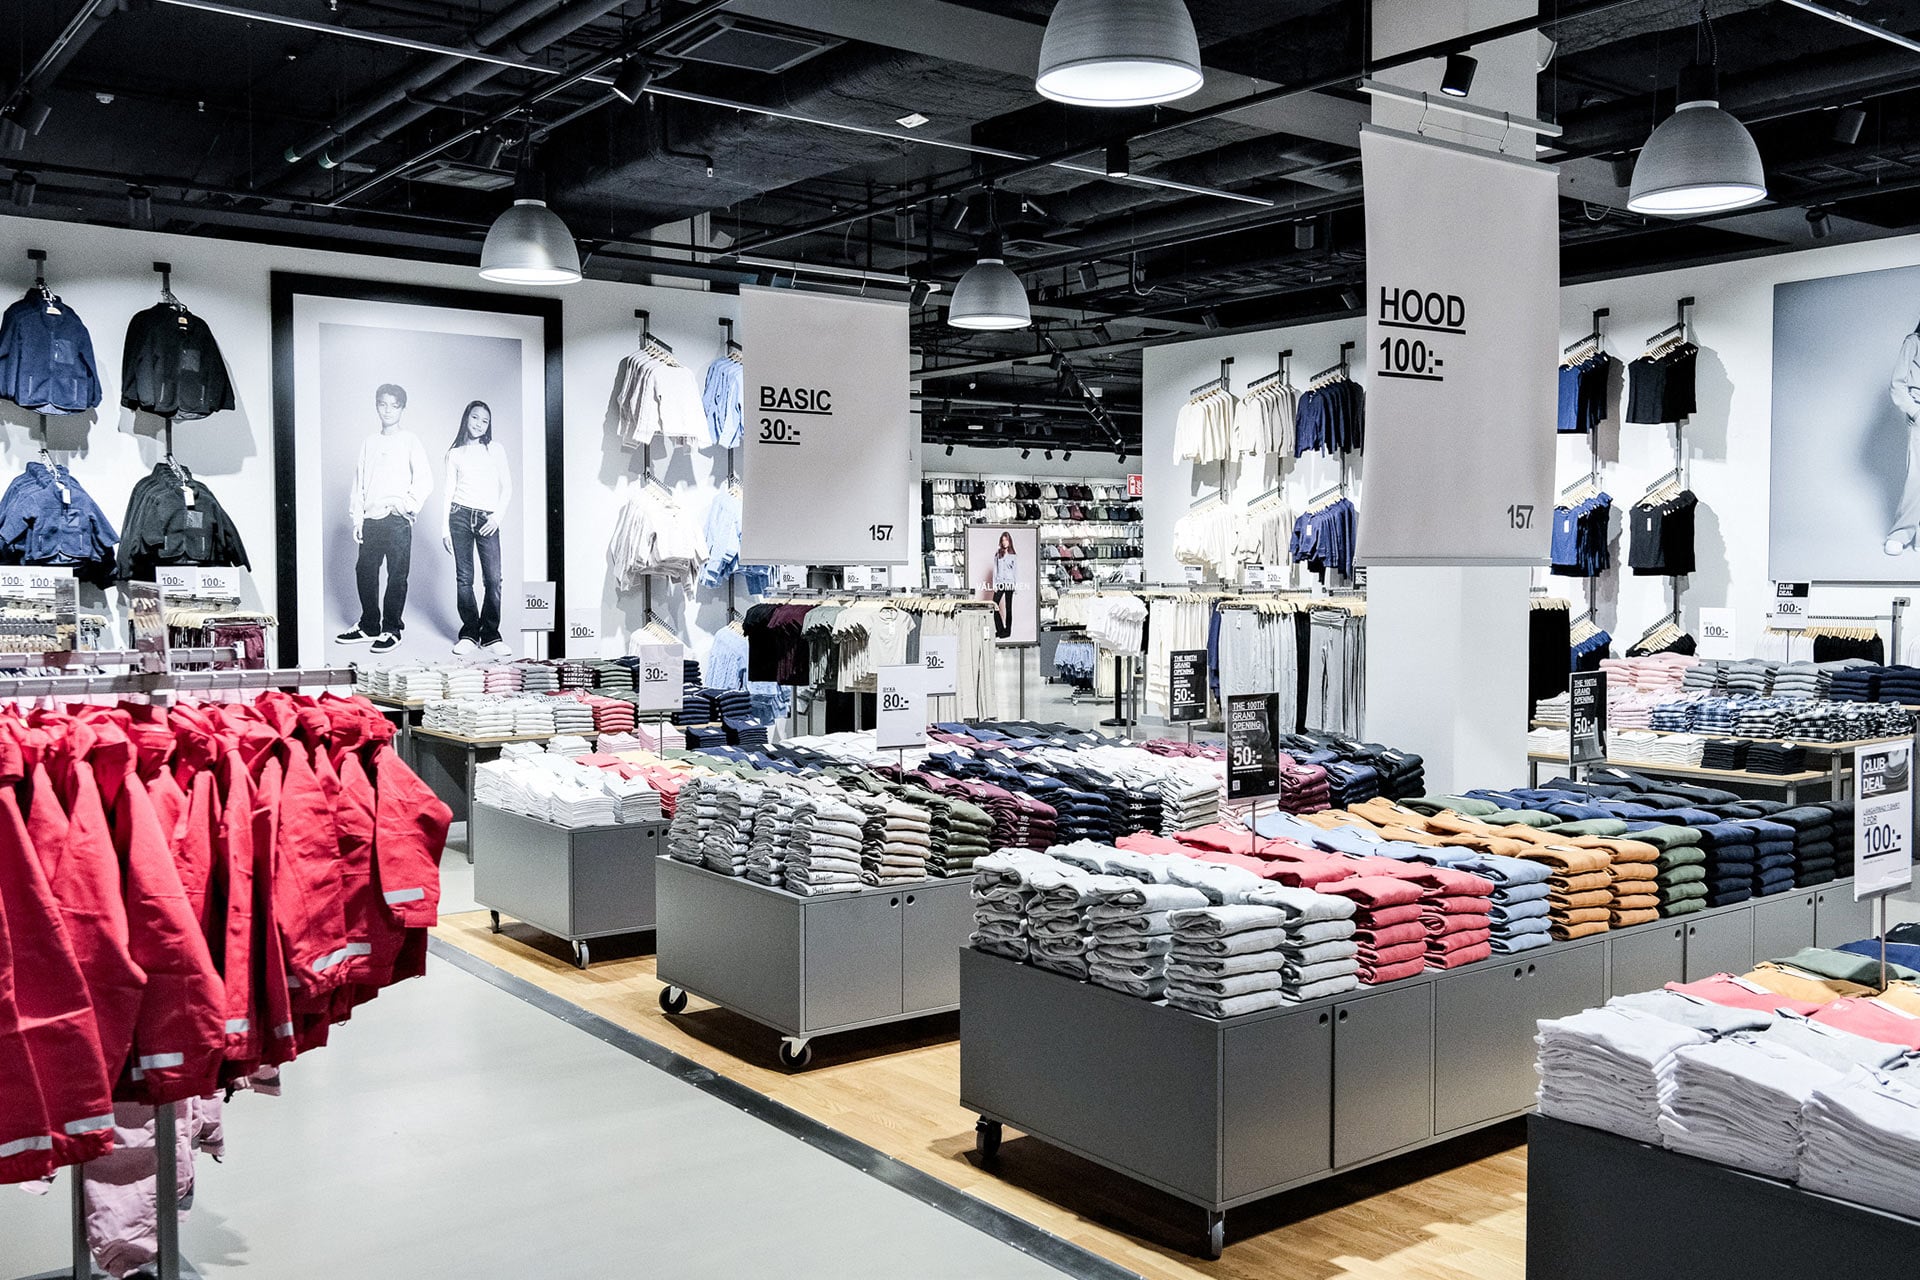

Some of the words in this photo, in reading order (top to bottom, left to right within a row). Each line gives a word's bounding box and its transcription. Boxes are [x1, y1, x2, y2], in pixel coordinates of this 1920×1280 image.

[1380, 286, 1465, 327] HOOD
[1379, 337, 1443, 374] 100:-
[760, 386, 832, 411] BASIC
[759, 418, 800, 440] 30:-
[1507, 504, 1533, 529] 157
[869, 524, 893, 541] 157
[162, 576, 184, 585] 100:-
[202, 577, 225, 587] 100:-
[526, 598, 548, 608] 100:-
[1778, 603, 1802, 613] 100:-
[571, 626, 594, 636] 100:-
[1704, 625, 1729, 636] 100:-
[926, 655, 944, 667] 30:-
[645, 668, 668, 680] 30:-
[883, 693, 909, 709] 80:-
[1174, 688, 1195, 701] 50:-
[1232, 702, 1245, 711] THE
[1247, 701, 1265, 709] 100TH
[1232, 711, 1256, 721] GRAND
[1232, 721, 1261, 731] OPENING
[1574, 717, 1595, 734] 50:-
[1233, 746, 1262, 766] 50:-
[1863, 757, 1886, 773] CLUB
[1863, 776, 1886, 791] DEAL
[1864, 823, 1901, 853] 100:-
